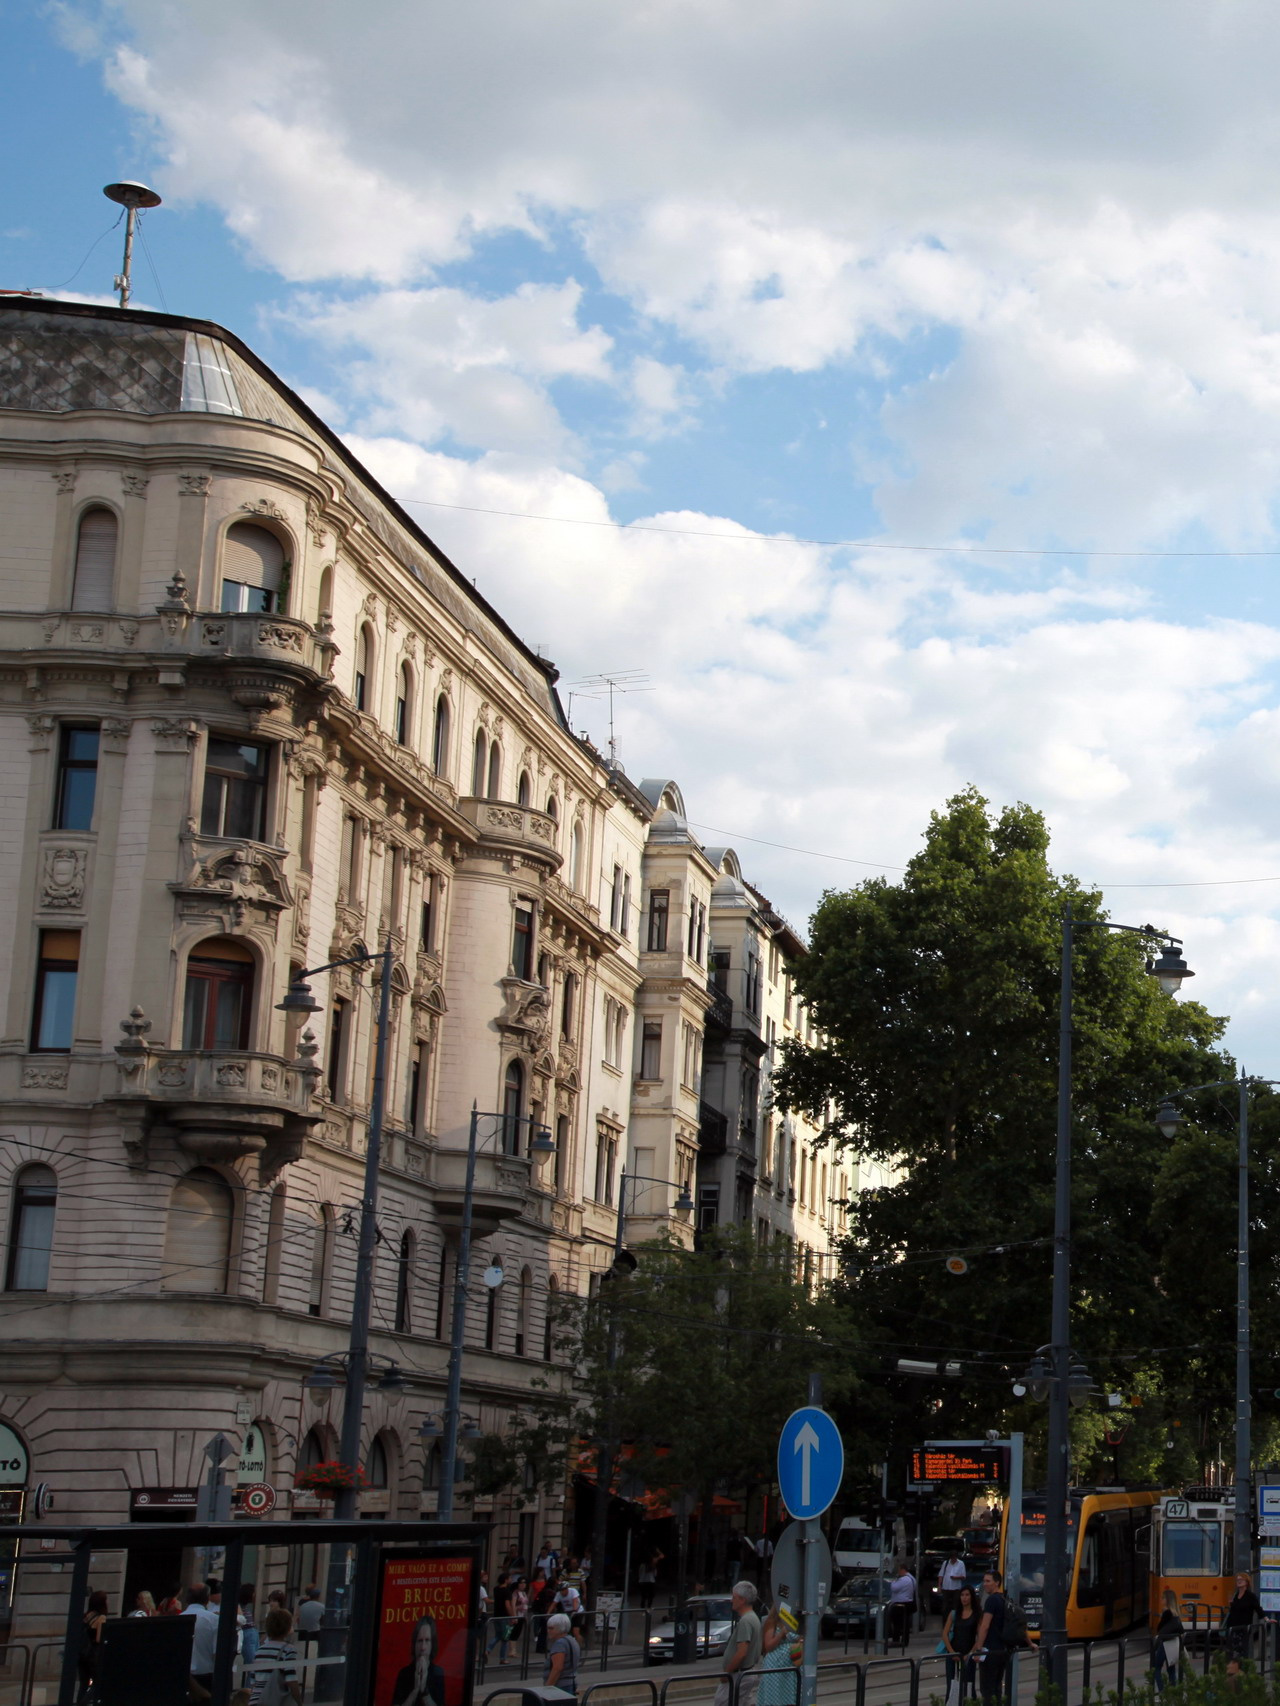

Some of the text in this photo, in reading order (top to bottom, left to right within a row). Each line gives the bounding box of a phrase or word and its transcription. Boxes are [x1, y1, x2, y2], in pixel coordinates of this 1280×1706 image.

[1169, 1503, 1185, 1516] 47
[439, 1564, 444, 1573] A
[403, 1587, 452, 1604] BRUCE
[385, 1604, 466, 1623] DICKINSON
